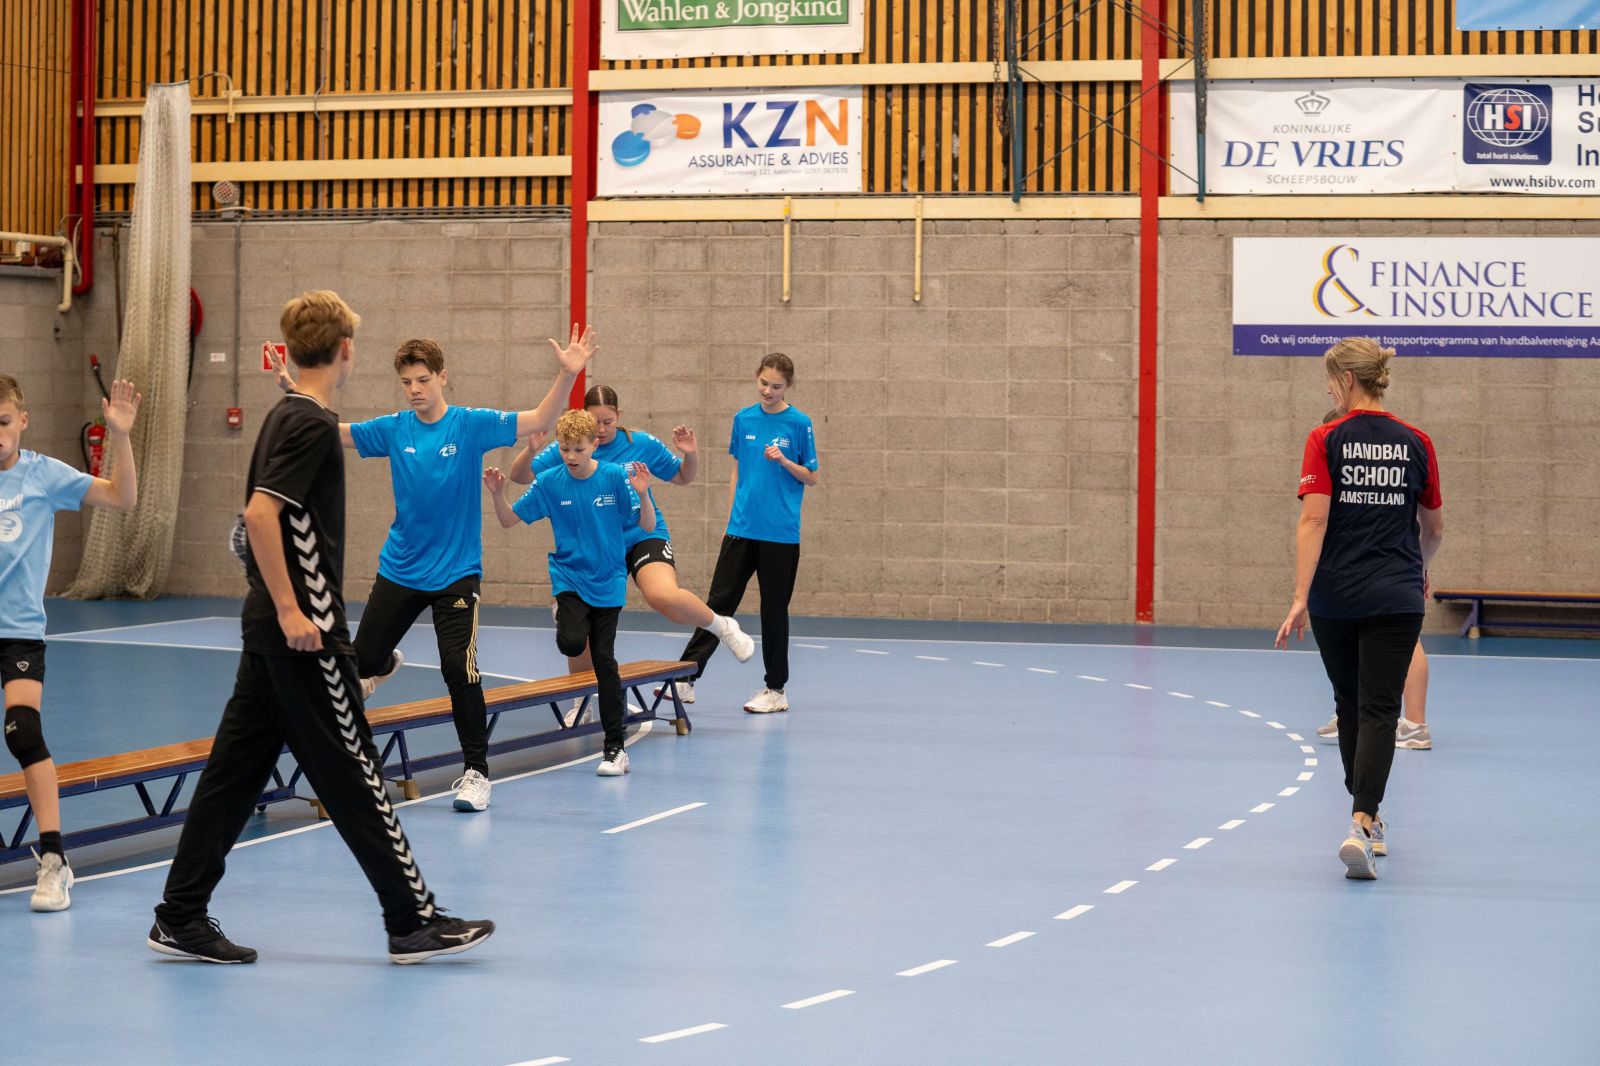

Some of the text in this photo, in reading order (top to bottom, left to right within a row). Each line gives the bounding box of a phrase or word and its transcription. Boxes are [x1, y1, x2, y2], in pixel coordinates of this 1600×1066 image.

[622, 0, 842, 23] Wahlen & Jongkind
[1578, 84, 1600, 106] H
[722, 99, 848, 149] KZN
[1483, 104, 1532, 130] HSI
[1577, 111, 1600, 133] S
[1273, 124, 1352, 135] KONINKLIJKE
[688, 151, 849, 168] ASSURANTIE & ADVIES
[1221, 139, 1405, 168] DE VRIES
[1266, 174, 1358, 185] SCHEEPSBOUW
[1490, 175, 1596, 188] www.hsibv.com
[1370, 261, 1527, 288] FINANCE
[1390, 292, 1594, 318] INSURANCE
[1260, 334, 1280, 344] Ook
[1281, 335, 1296, 346] wij
[1383, 335, 1479, 348] topsportprogramma
[1480, 336, 1498, 345] van
[1500, 335, 1588, 348] handbalvereniging
[1342, 442, 1411, 461] HANDBAL
[1341, 465, 1408, 487] SCHOOL
[1339, 491, 1405, 506] AMSTELLAND
